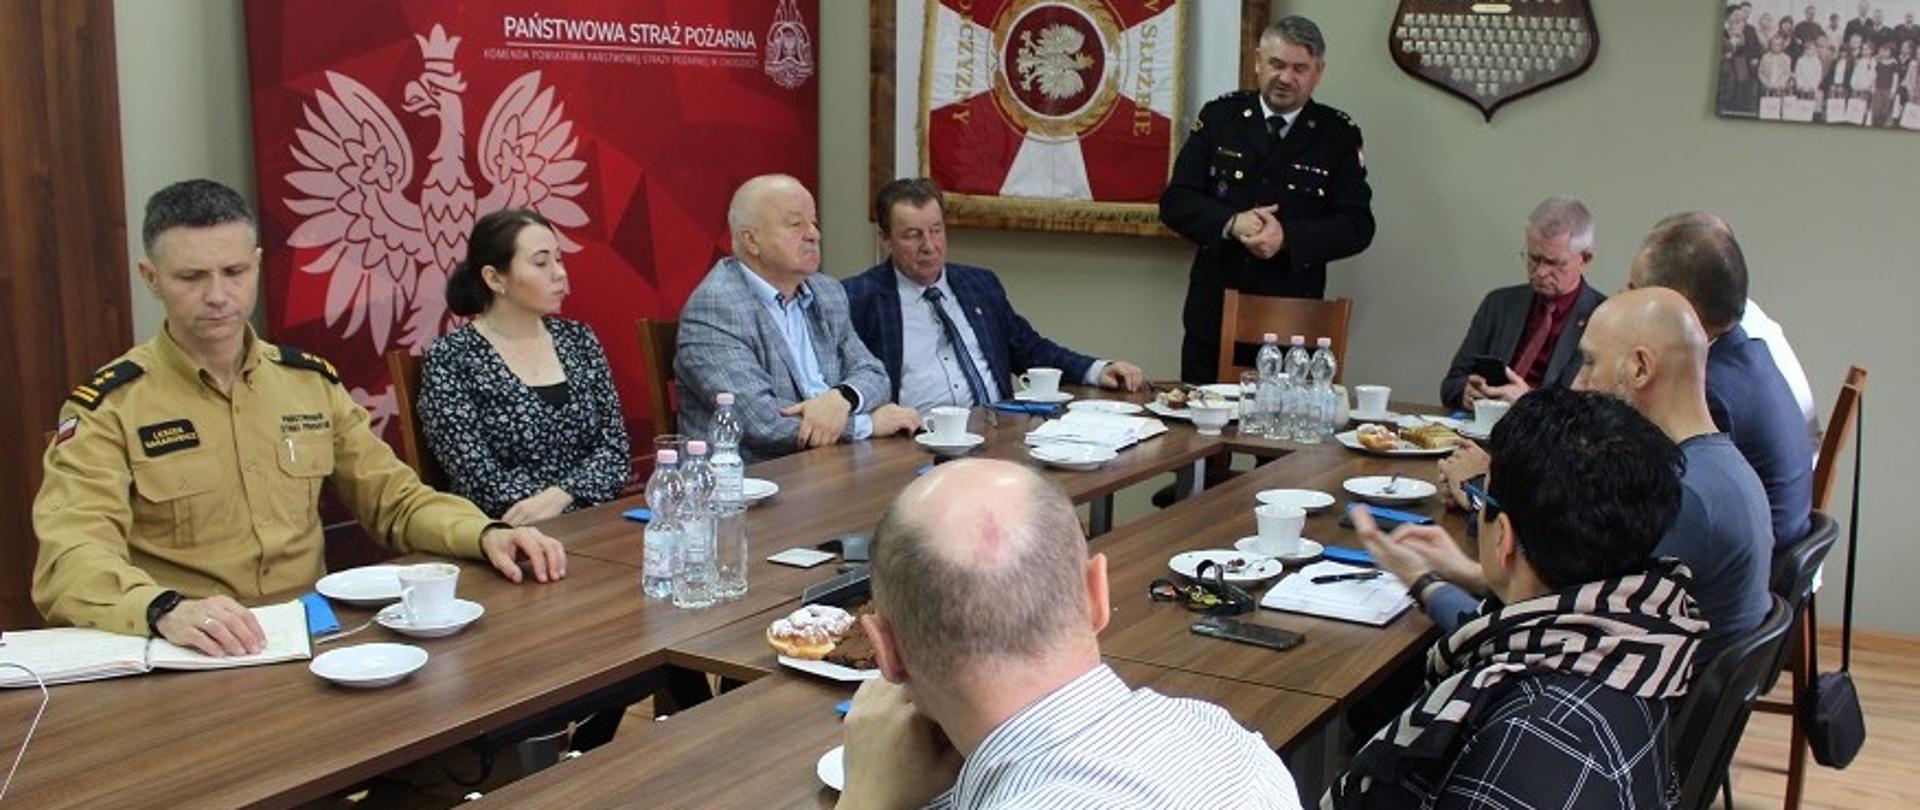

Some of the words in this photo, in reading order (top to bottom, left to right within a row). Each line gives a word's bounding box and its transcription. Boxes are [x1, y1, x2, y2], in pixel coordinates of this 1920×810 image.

[504, 12, 627, 42] PAŃSTWOWA
[629, 21, 681, 45] STRAŻ
[685, 24, 757, 49] POŻARNA
